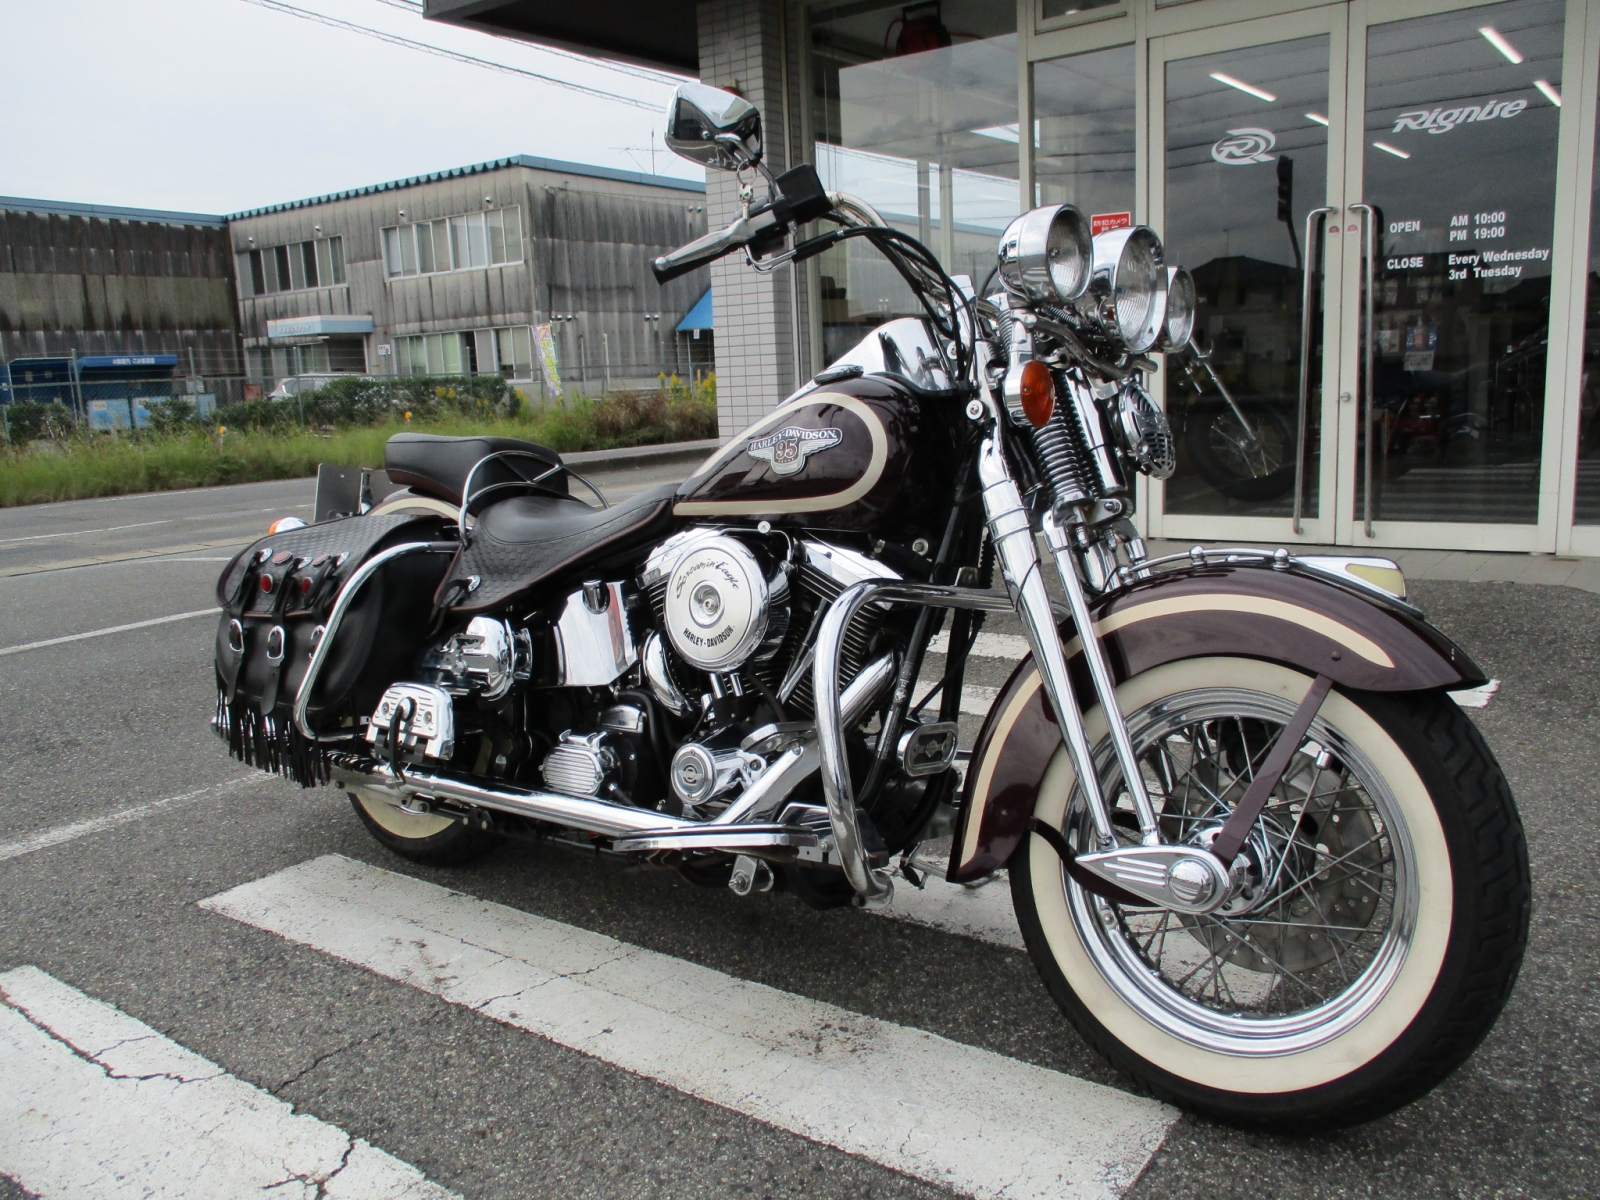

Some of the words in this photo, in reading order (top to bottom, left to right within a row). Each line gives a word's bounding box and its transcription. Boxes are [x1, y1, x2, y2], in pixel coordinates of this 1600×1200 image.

[1389, 220, 1421, 234] OPEN
[1450, 214, 1469, 227] AM
[1473, 211, 1506, 225] 10:00
[1449, 229, 1467, 242] PM
[1473, 226, 1505, 240] 19:00
[1386, 256, 1424, 270] CLOSE
[1448, 253, 1480, 267] Every
[1482, 247, 1550, 263] Wednesday
[1448, 268, 1467, 281] 3rd
[1473, 265, 1523, 278] Tuesday
[775, 438, 798, 460] 95
[715, 560, 740, 590] Eagle
